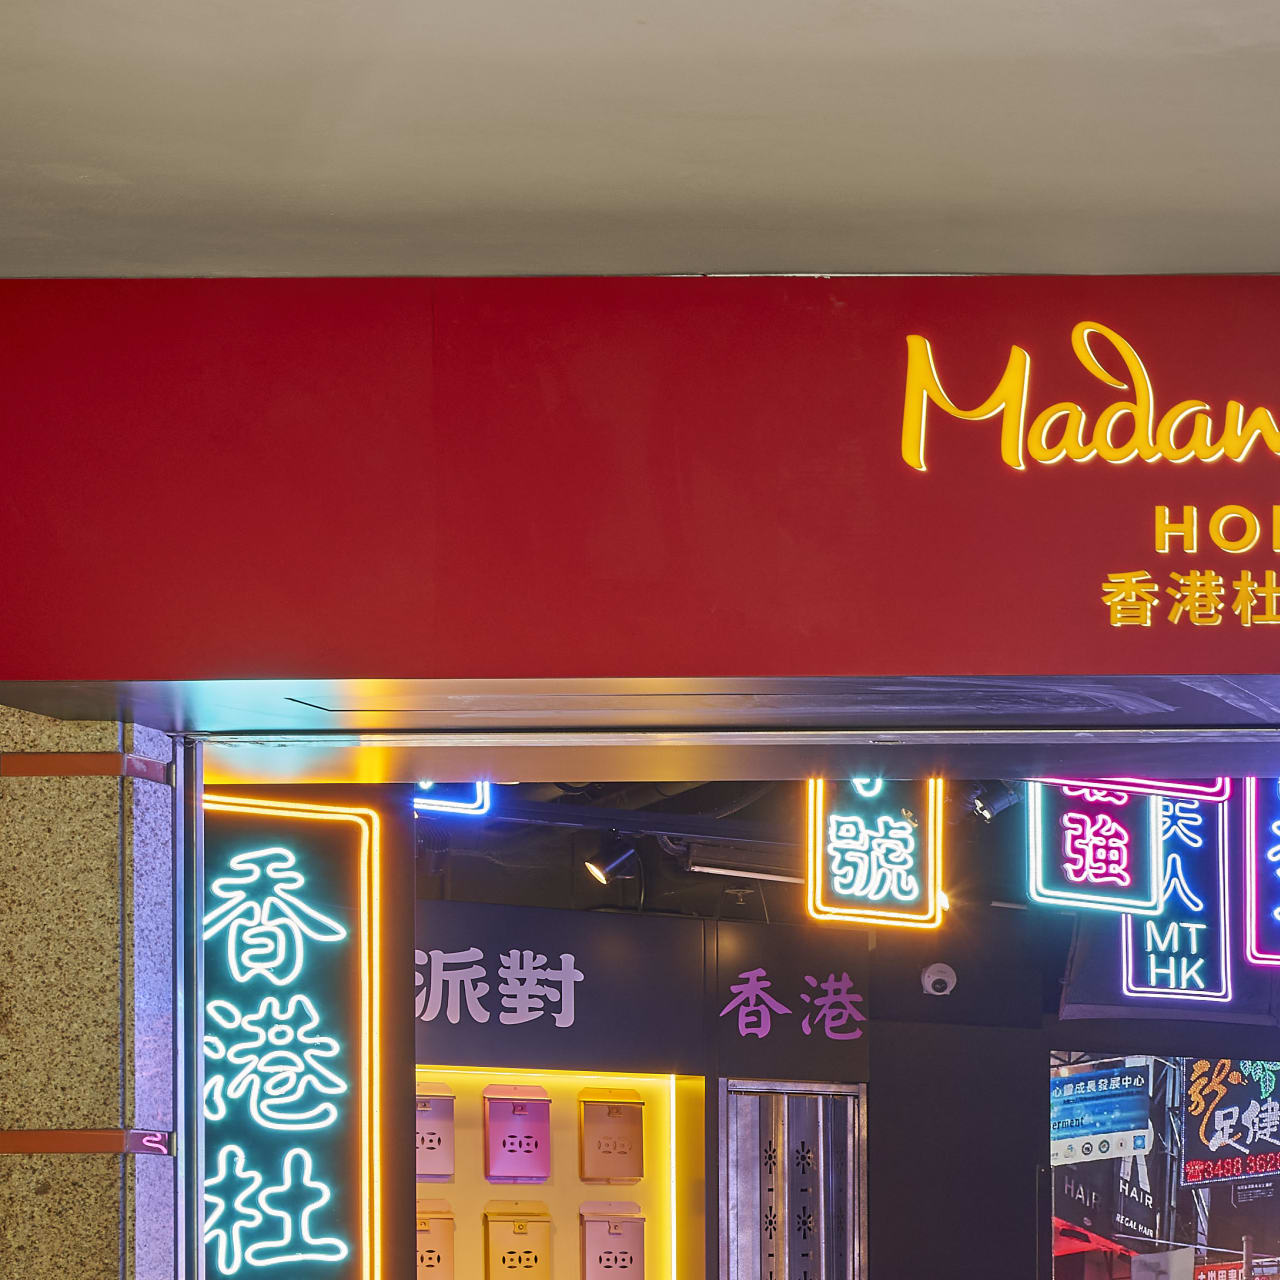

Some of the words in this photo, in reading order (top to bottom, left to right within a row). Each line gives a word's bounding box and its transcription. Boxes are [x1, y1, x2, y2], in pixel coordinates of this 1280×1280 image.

[827, 780, 919, 901] 號
[1062, 787, 1131, 886] 強
[1145, 920, 1206, 954] MT
[415, 947, 584, 1028] 派對
[1147, 953, 1205, 989] HK
[719, 967, 868, 1040] 香港
[1119, 1179, 1154, 1209] HAIR
[1115, 1213, 1138, 1231] REGAL
